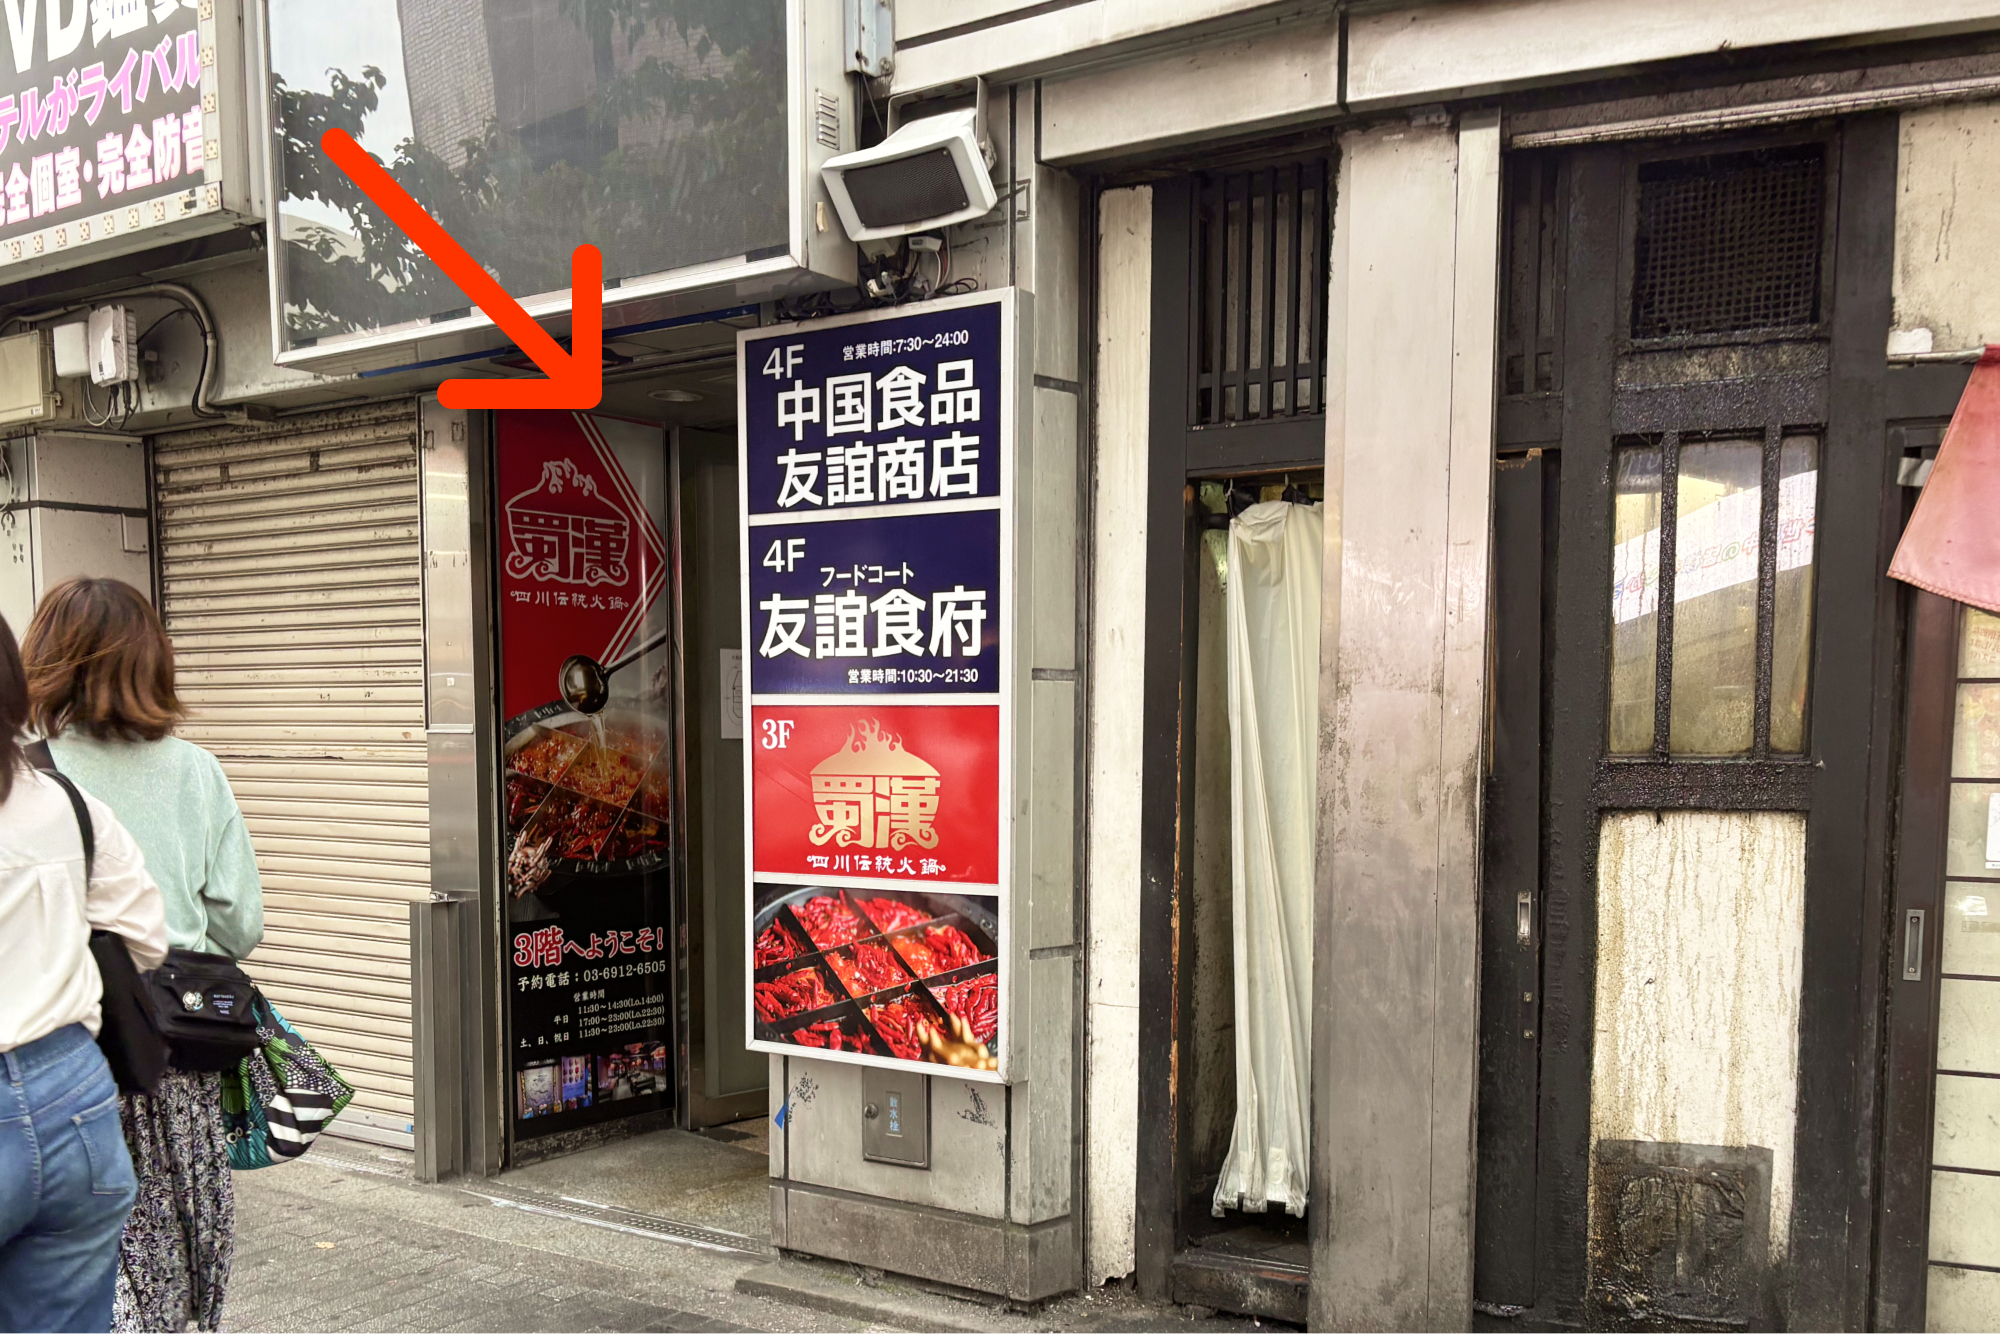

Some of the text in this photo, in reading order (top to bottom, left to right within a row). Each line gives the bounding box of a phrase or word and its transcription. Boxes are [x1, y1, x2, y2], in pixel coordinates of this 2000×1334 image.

[0, 105, 204, 227] 全個室・完全防音
[763, 344, 804, 380] 4F
[777, 358, 981, 441] 中国食品
[776, 431, 980, 508] 友誼商店
[763, 538, 806, 573] 4F
[820, 561, 915, 588] フードコート
[510, 590, 630, 611] 四川伝統火鍋
[759, 585, 987, 659] 友誼食府
[762, 719, 795, 749] 3F
[806, 854, 947, 876] 四川伝統火鍋
[513, 924, 664, 968] 3階へようこそ!
[573, 989, 605, 1003] 営業時間
[553, 1014, 569, 1025] 平日
